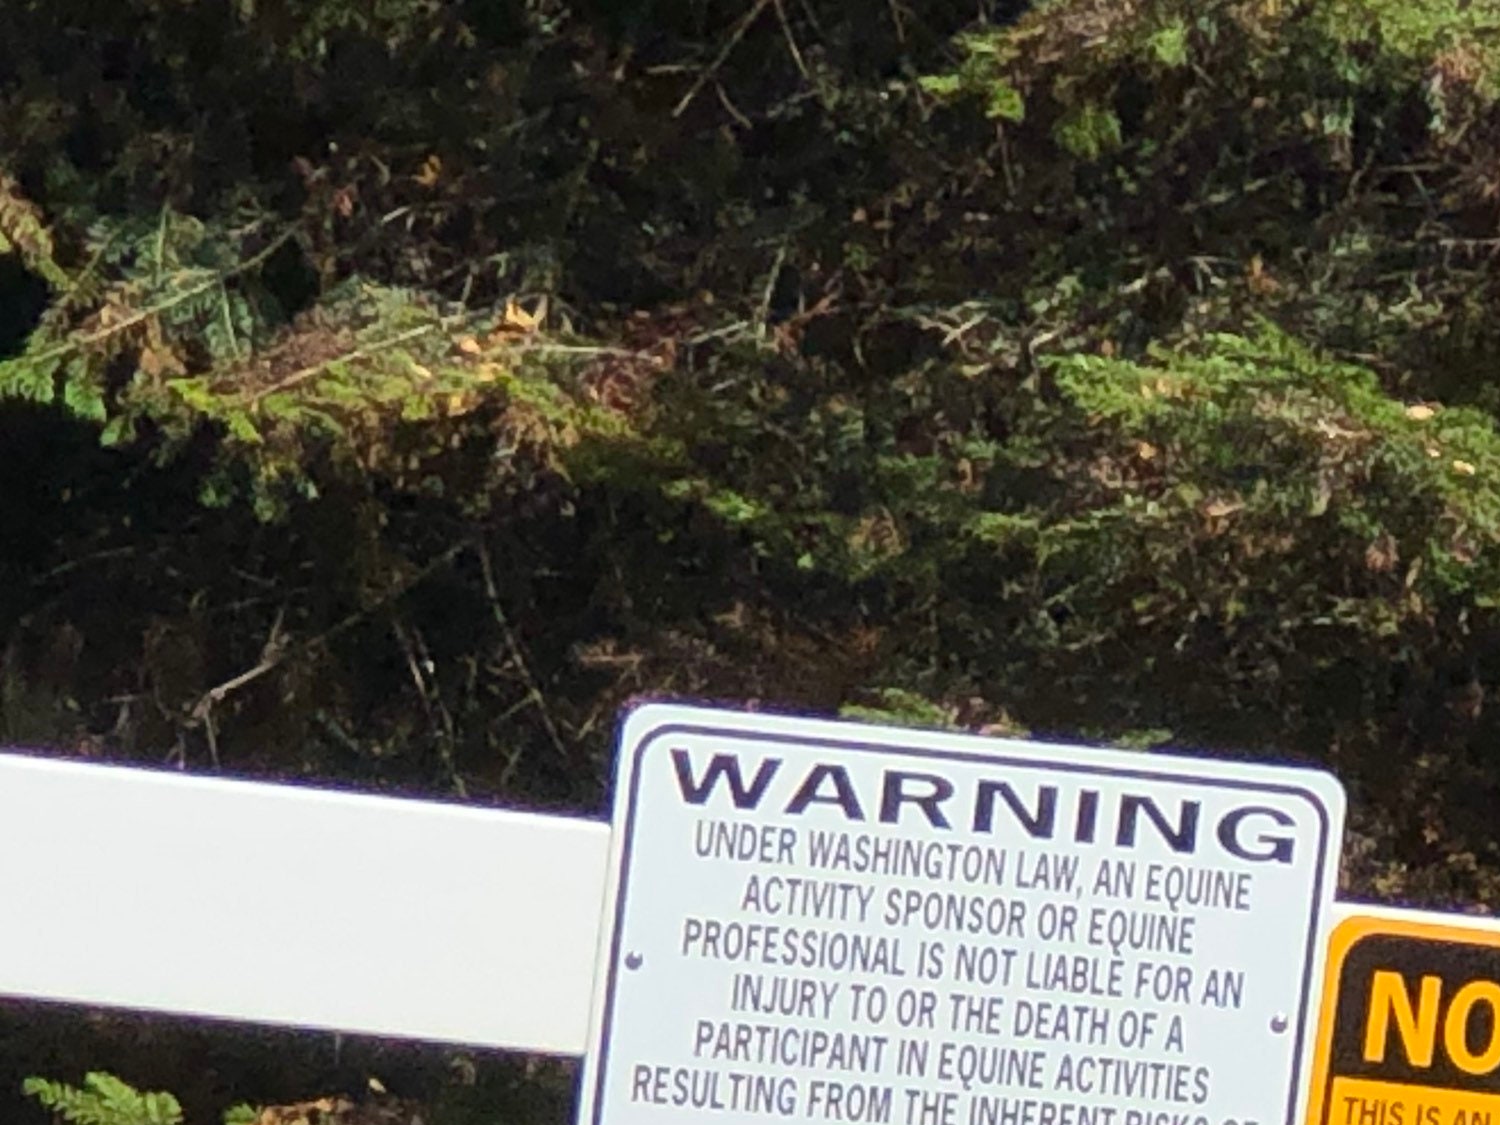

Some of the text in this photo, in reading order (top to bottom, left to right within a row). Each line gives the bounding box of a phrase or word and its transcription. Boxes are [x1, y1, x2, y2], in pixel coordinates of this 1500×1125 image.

[670, 748, 1295, 864] WARNING
[695, 819, 1252, 913] UNDER WASHINGTON LAW, AN EQUINE
[741, 874, 1196, 957] ACTIVITY SPONSOR OR EQUINE
[682, 918, 1244, 1009] PROFESSIONAL IS NOT LIABLE FOR AN
[731, 973, 1184, 1053] INJURY TO OR THE DEATH OF A
[631, 1064, 797, 1116] RESULTING
[806, 1080, 893, 1124] FROM
[693, 1019, 1210, 1105] PARTICIPANT IN EQUINE ACTIVITIES
